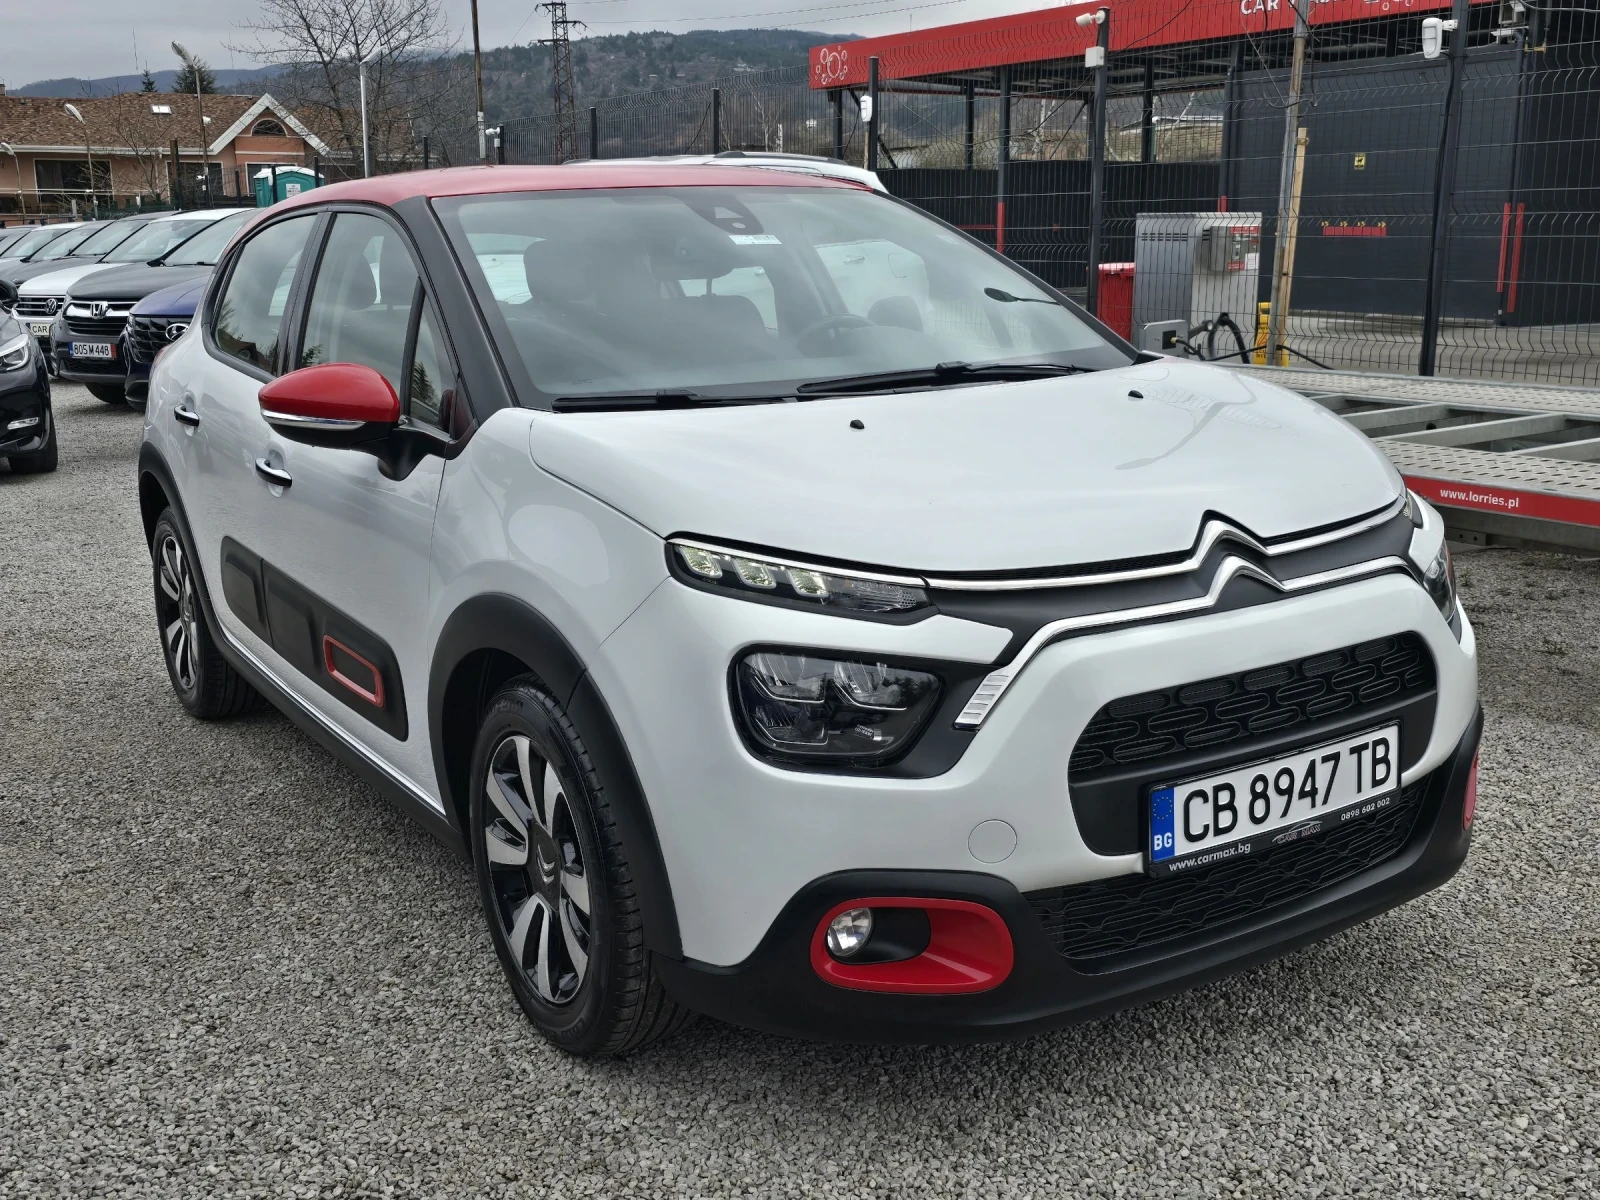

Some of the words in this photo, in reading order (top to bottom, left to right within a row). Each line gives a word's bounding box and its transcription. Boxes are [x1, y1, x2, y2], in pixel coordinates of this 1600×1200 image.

[1240, 0, 1279, 15] CAR
[32, 325, 48, 334] CAR
[1440, 489, 1519, 509] www.lorries.pl
[1182, 781, 1239, 844] CB
[1249, 750, 1342, 826] 8947
[1348, 736, 1392, 795] TB
[1340, 808, 1360, 821] 0898
[1361, 802, 1376, 814] 602
[1376, 796, 1390, 808] 002
[1153, 831, 1174, 851] BG
[1168, 842, 1252, 872] www.carmax.bg
